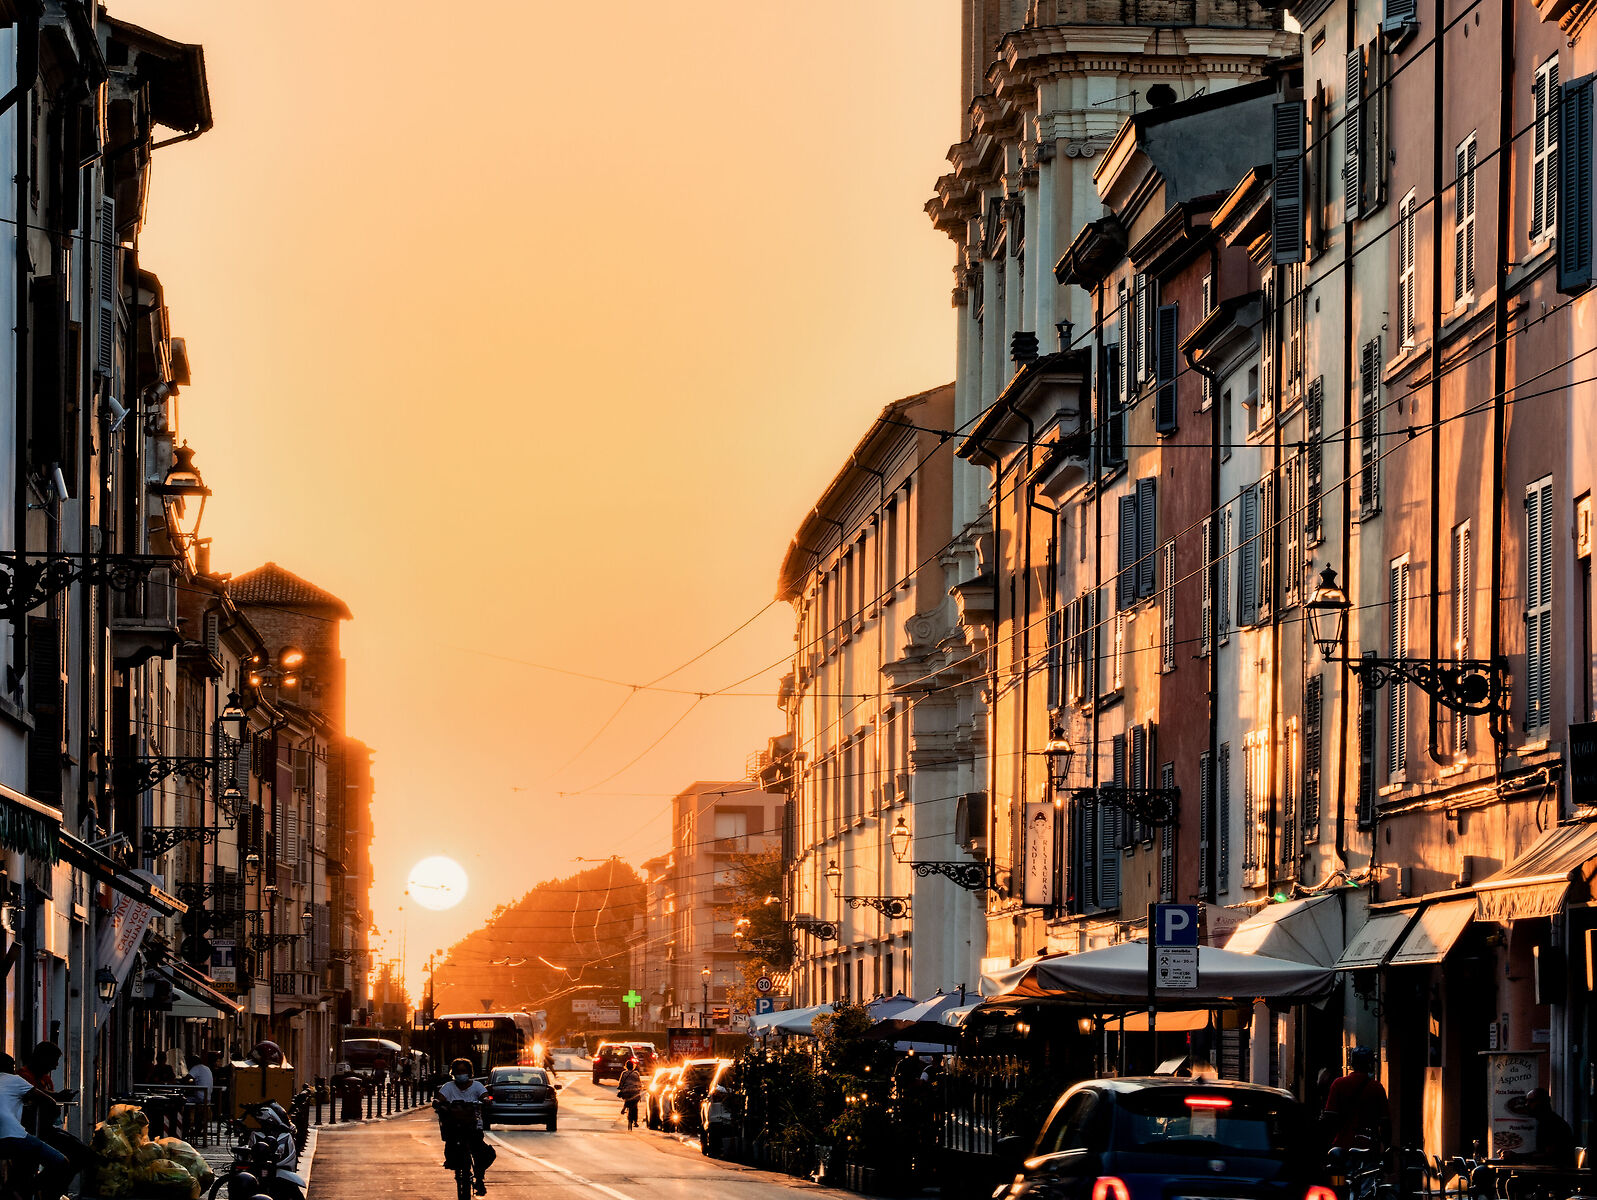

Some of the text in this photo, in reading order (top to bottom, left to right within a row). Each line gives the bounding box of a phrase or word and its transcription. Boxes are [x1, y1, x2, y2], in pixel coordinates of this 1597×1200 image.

[124, 905, 151, 955] COUNTRY
[1164, 908, 1190, 942] P
[118, 928, 133, 951] CALL
[759, 980, 770, 989] 30
[760, 999, 770, 1013] P
[448, 1020, 495, 1029] 5 Via ORAZIO
[1496, 1057, 1532, 1070] PIZZERIA
[1498, 1073, 1532, 1084] Asporto
